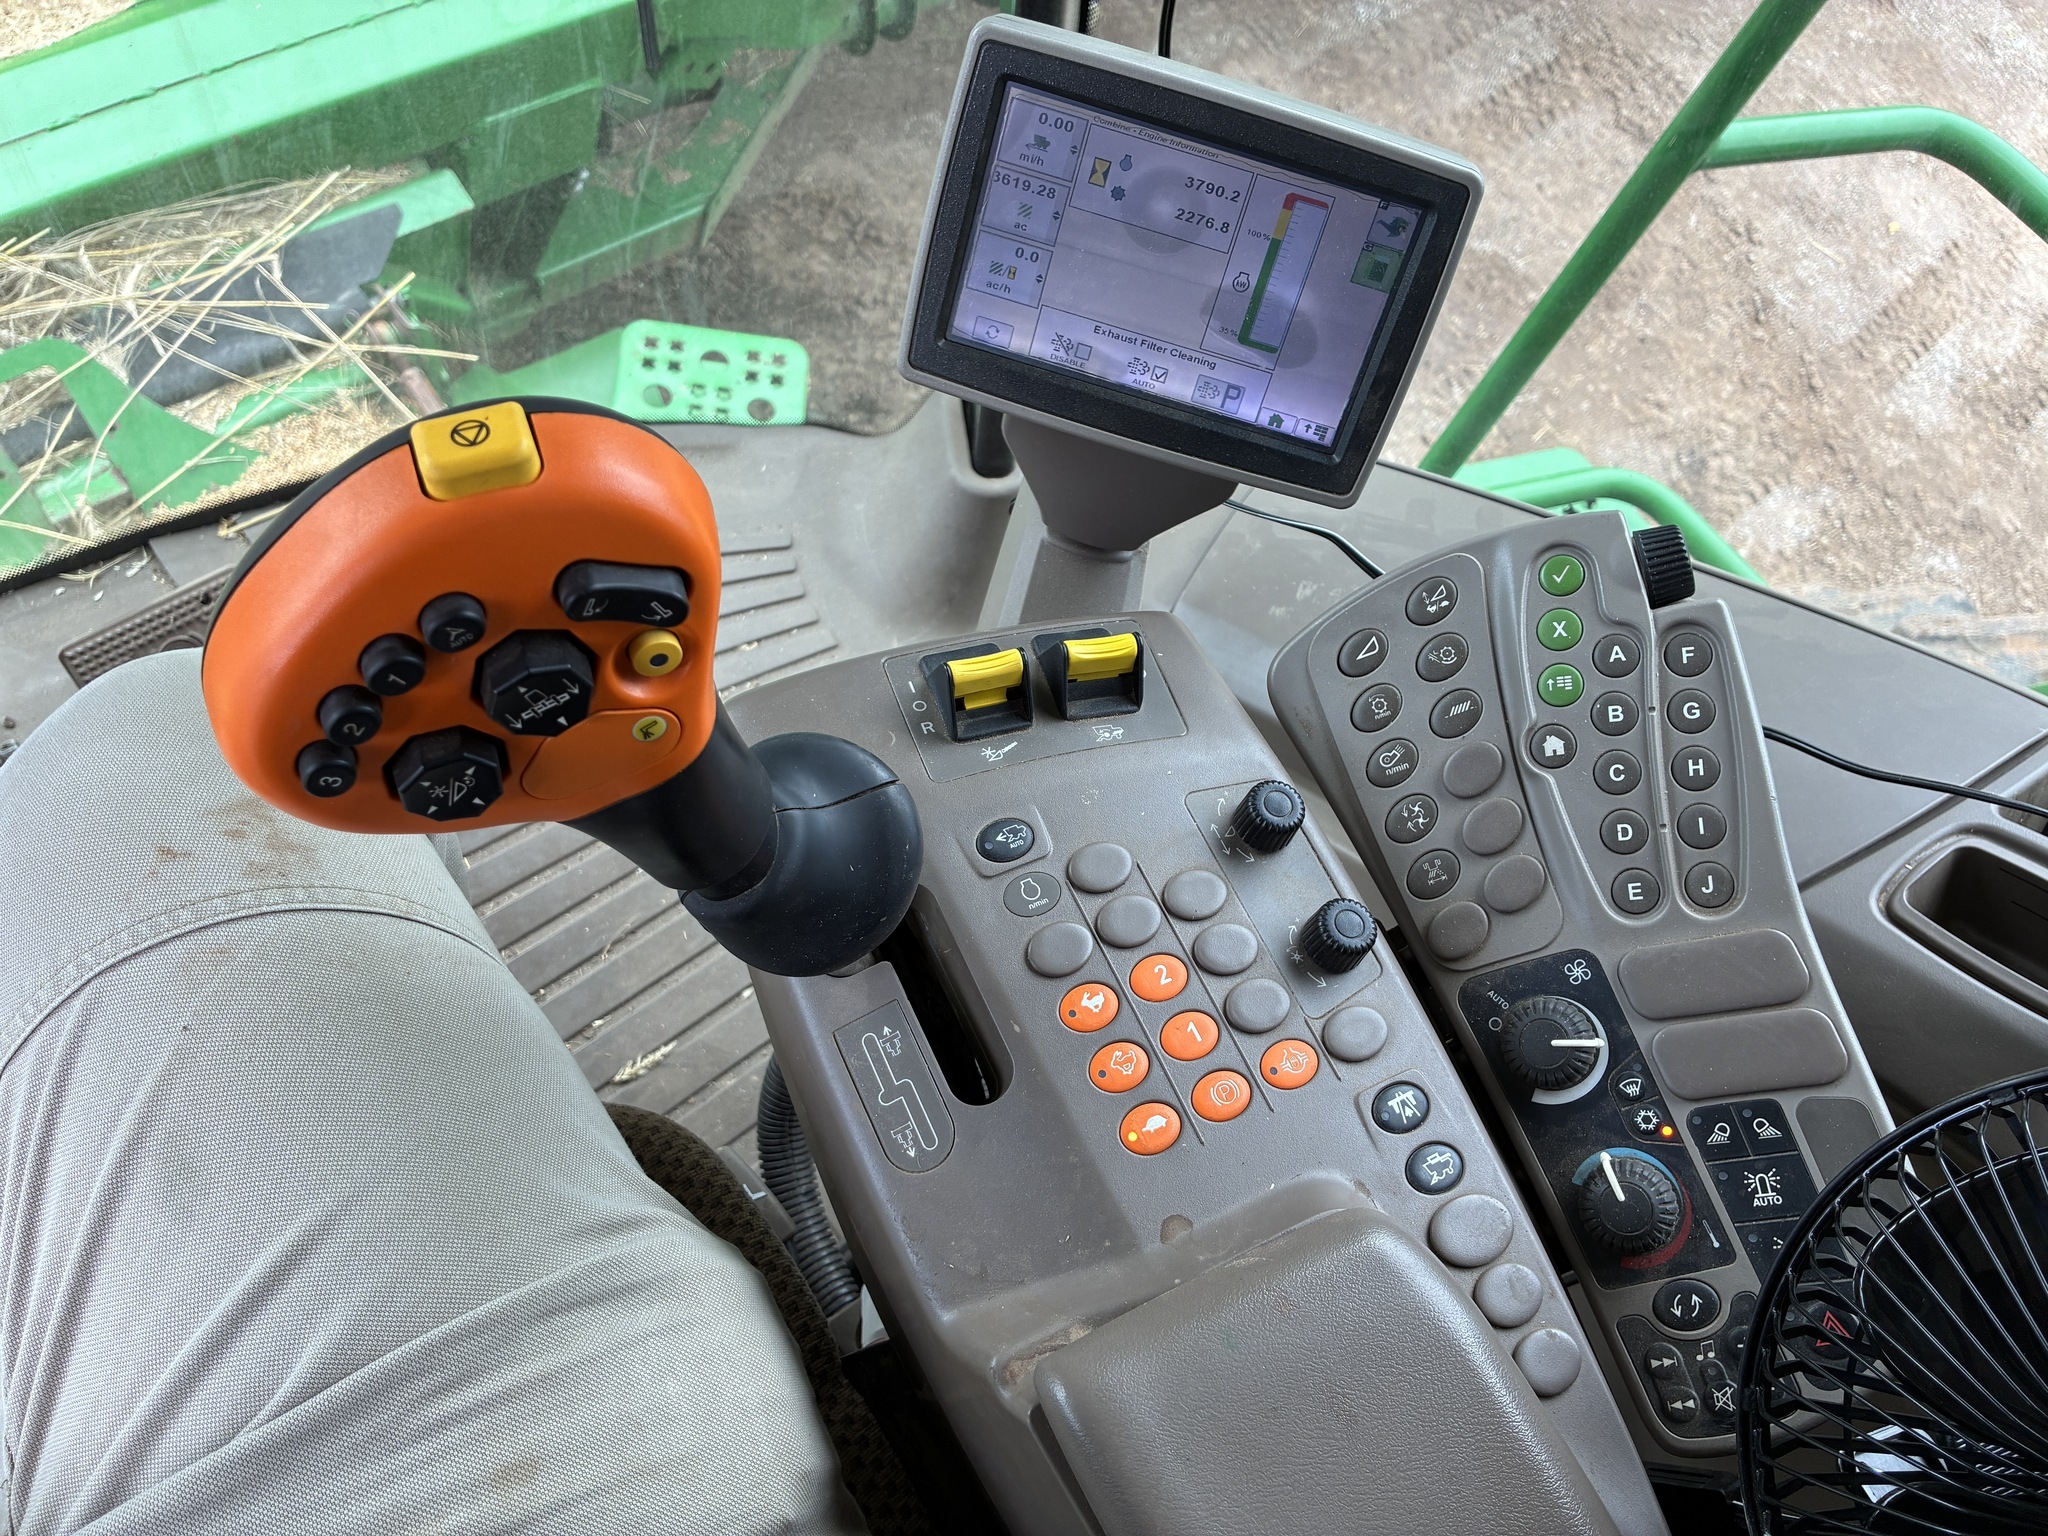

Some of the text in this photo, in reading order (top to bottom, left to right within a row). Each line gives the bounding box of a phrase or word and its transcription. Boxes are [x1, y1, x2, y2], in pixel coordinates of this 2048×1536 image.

[1038, 112, 1074, 133] 0.00
[1093, 115, 1131, 132] Combine
[1138, 128, 1168, 144] Engine
[1169, 138, 1219, 159] Information
[1019, 153, 1045, 167] mi/h
[993, 170, 1056, 199] 3619.28
[1184, 176, 1241, 203] 3790.2
[1013, 221, 1028, 231] ac
[1174, 208, 1230, 234] 2276.8
[1015, 247, 1040, 263] 0.0
[985, 280, 1011, 294] ac/h
[1093, 324, 1217, 370] Exhaust Filter Cleaning
[1050, 353, 1086, 369] DISABLE
[1132, 378, 1156, 390] AUTO
[1221, 384, 1242, 409] P
[1552, 621, 1568, 638] X
[450, 633, 475, 648] AUTO
[1609, 646, 1627, 663] A
[1681, 646, 1695, 663] F
[388, 673, 406, 685] 1
[1608, 705, 1624, 722] B
[1682, 702, 1701, 720] G
[343, 723, 366, 737] 2
[921, 721, 936, 735] R
[1385, 762, 1410, 776] n/min
[1609, 764, 1625, 781] C
[1688, 758, 1704, 777] H
[319, 775, 342, 789] 3
[1617, 824, 1633, 842] D
[1698, 817, 1705, 835] I
[1009, 839, 1024, 849] AUTO
[1627, 883, 1644, 901] E
[1701, 875, 1714, 894] J
[1028, 898, 1050, 910] n/min
[1154, 964, 1173, 985] 2
[1486, 989, 1510, 1010] AUTO
[1187, 1021, 1202, 1042] 1
[1219, 1084, 1231, 1101] P
[1752, 1195, 1783, 1208] AUTO
